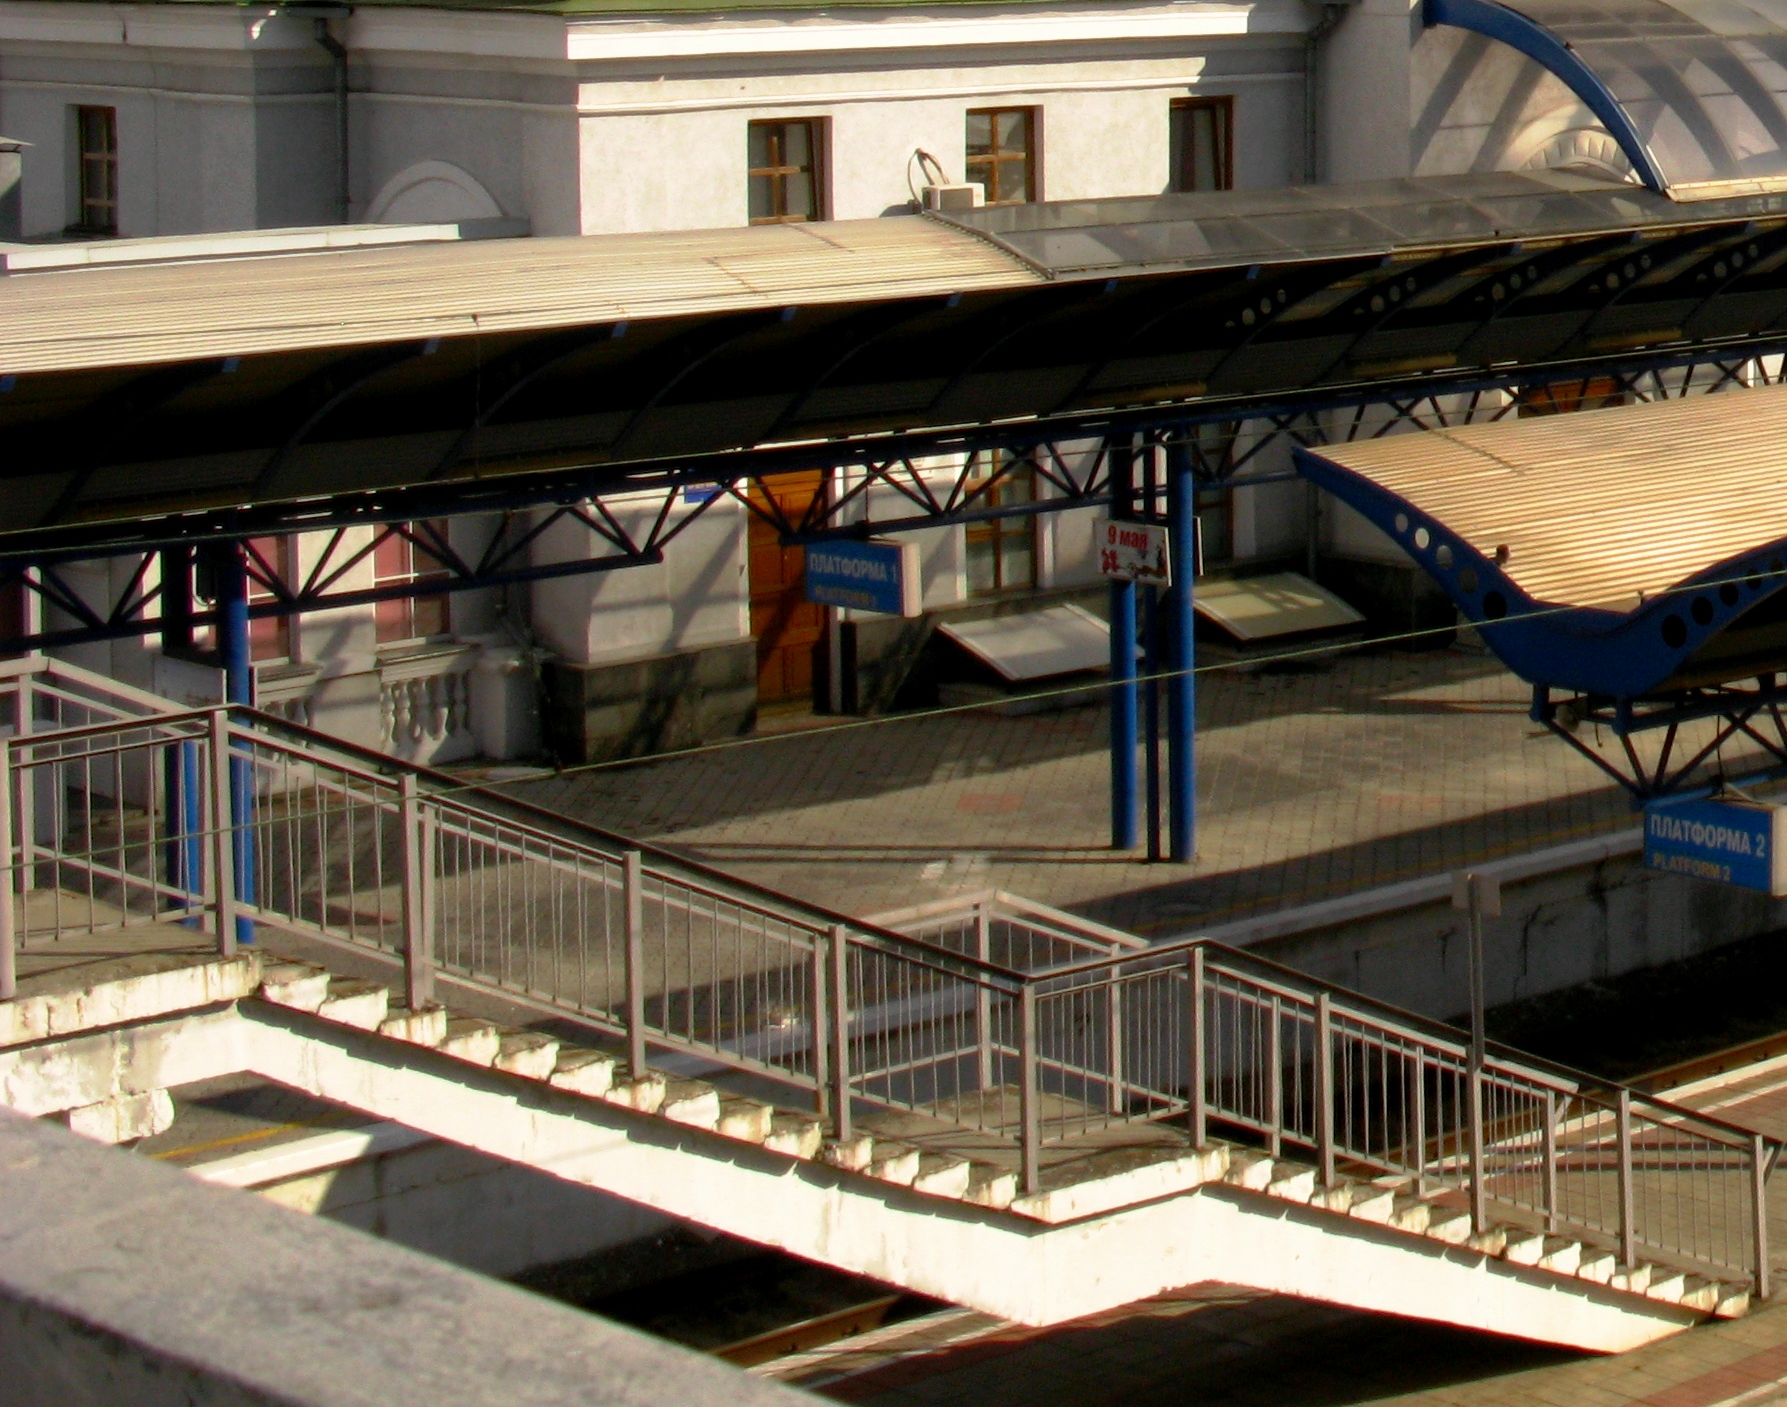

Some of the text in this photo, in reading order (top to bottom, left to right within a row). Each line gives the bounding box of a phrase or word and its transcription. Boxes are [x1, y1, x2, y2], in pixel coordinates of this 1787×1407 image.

[1108, 526, 1148, 549] 9 мая
[1650, 814, 1766, 859] ПЛАТФОРМА 2
[1652, 852, 1720, 878] PLATFORM
